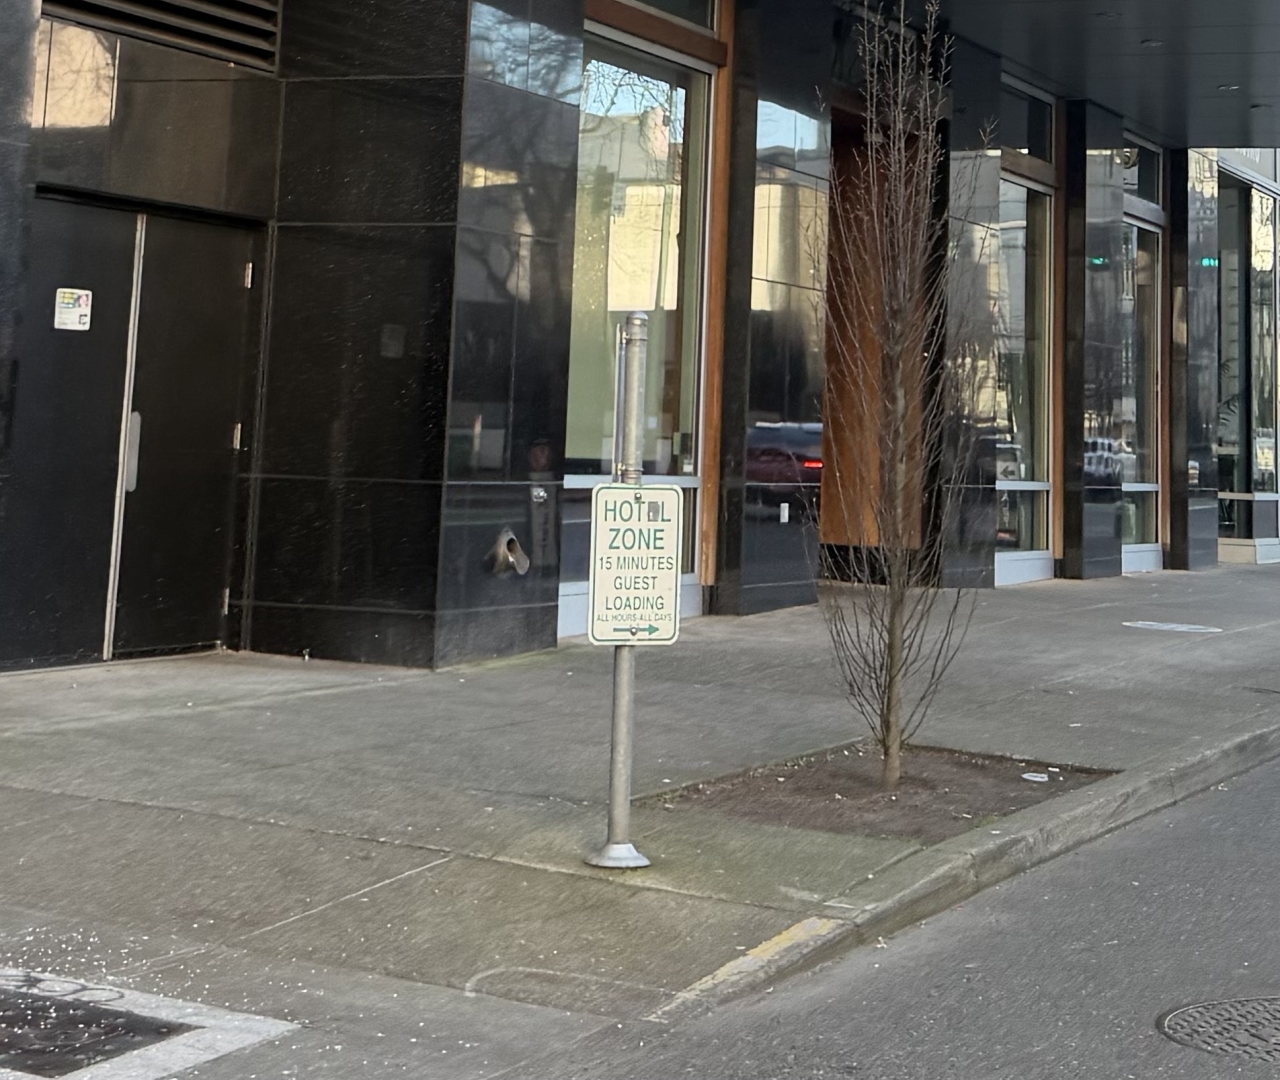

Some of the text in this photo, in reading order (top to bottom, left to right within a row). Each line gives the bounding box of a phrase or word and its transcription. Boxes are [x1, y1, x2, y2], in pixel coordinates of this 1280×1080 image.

[608, 528, 665, 550] ZONE
[599, 556, 674, 570] 15 MINUTES
[613, 576, 658, 590] GUEST
[605, 595, 665, 611] LOADING
[596, 613, 609, 621] ALL
[654, 613, 672, 621] DAYS
